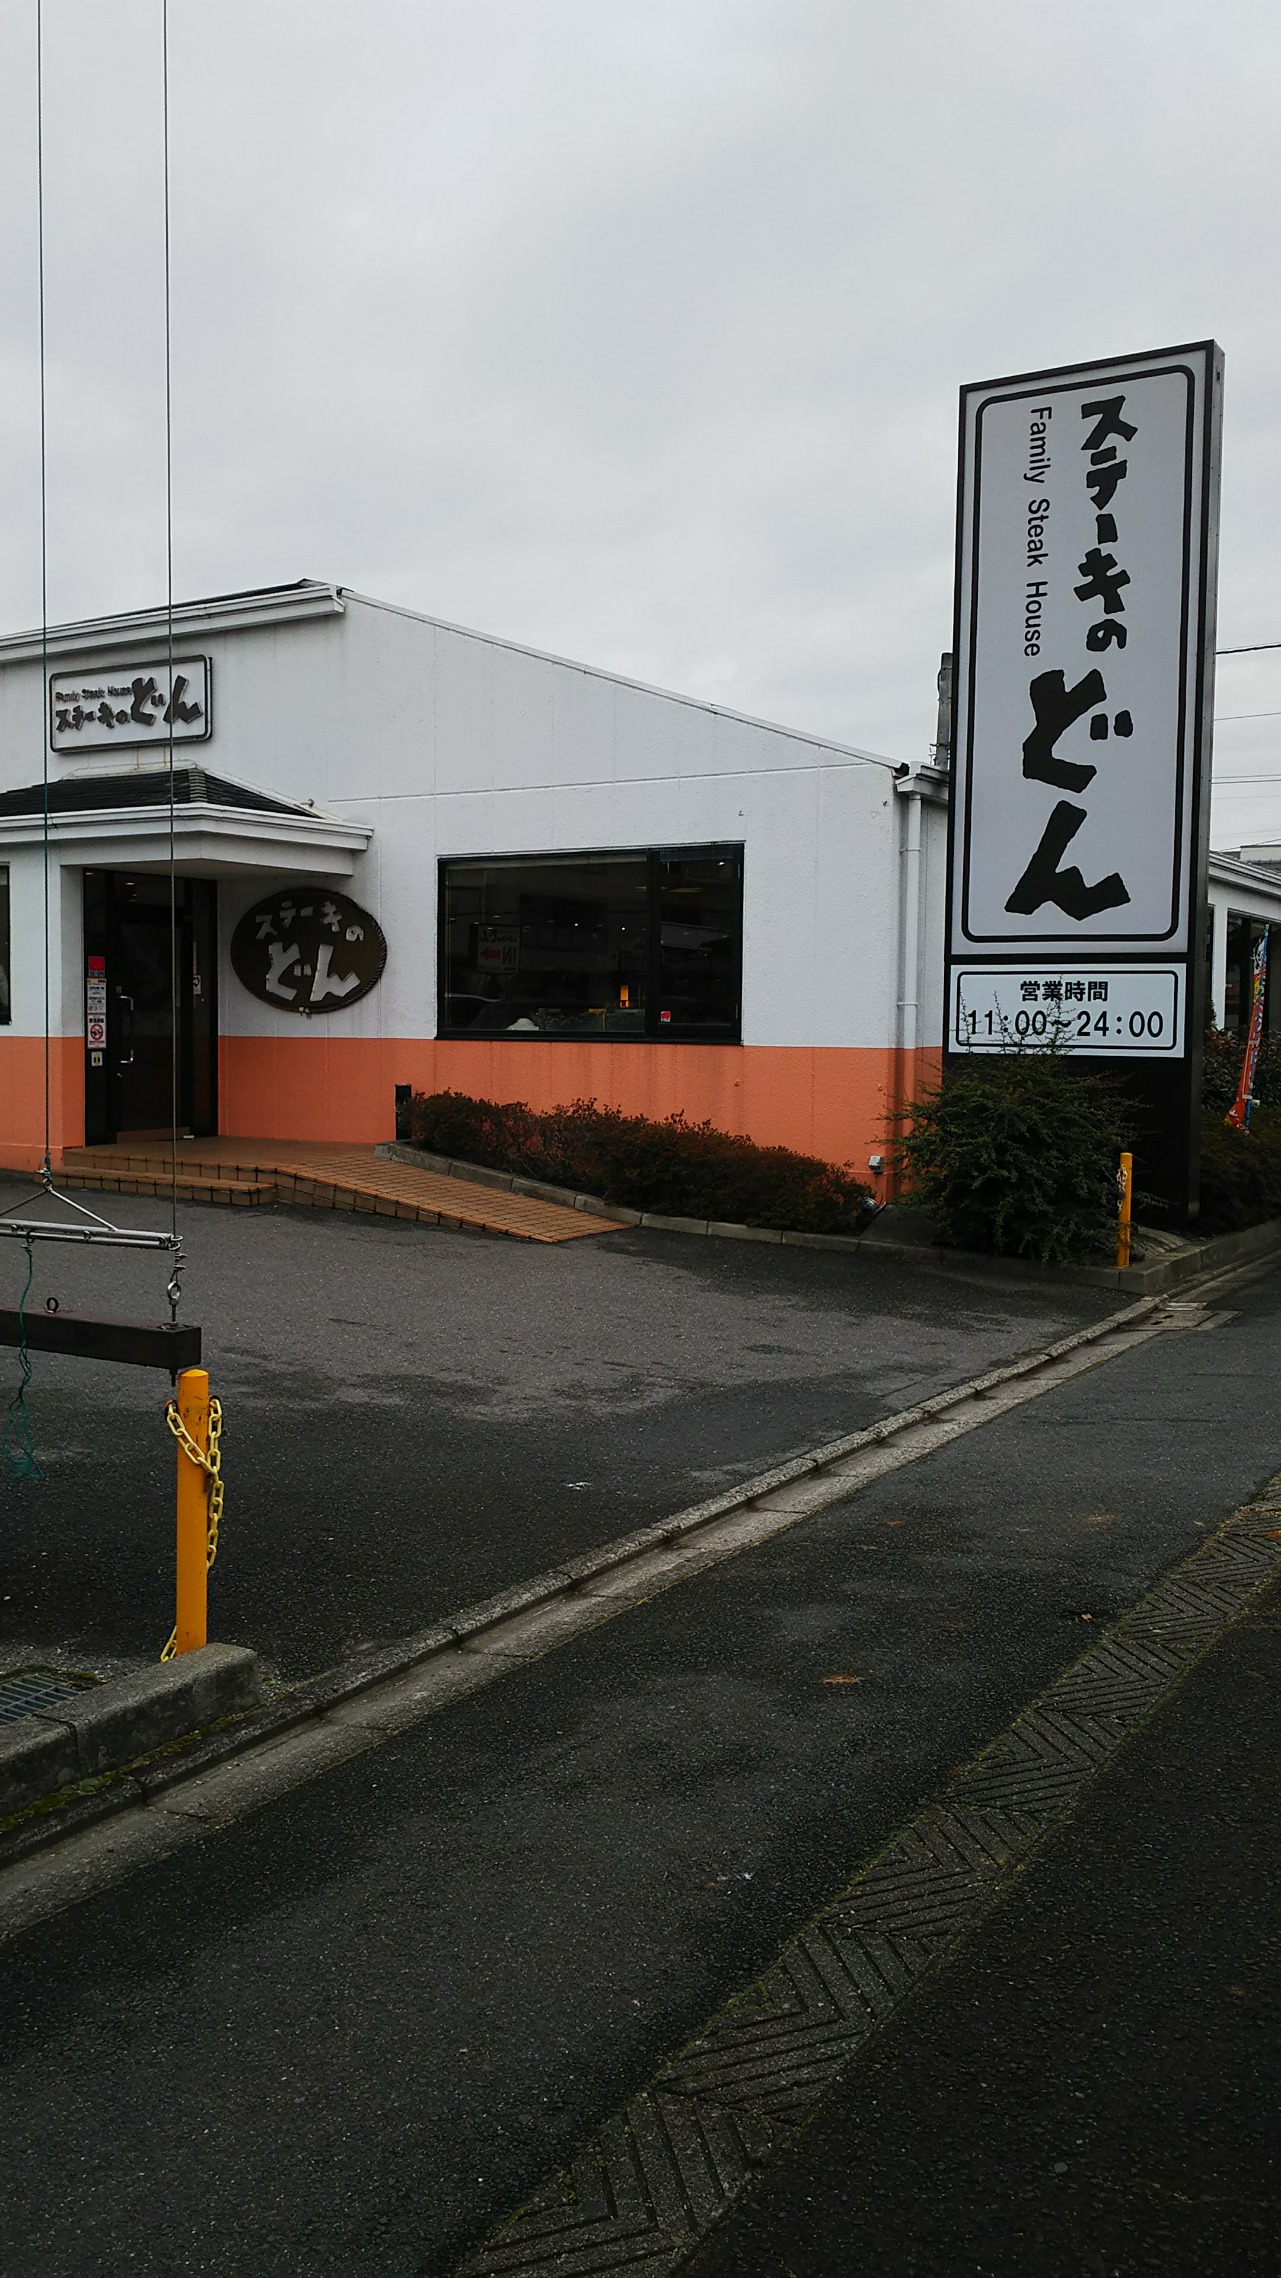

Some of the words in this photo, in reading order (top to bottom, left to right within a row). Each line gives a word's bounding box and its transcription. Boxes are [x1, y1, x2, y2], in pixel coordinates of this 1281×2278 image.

[1024, 406, 1053, 484] Family
[1026, 498, 1051, 568] Steak
[1024, 580, 1049, 657] House
[1019, 980, 1109, 1002] 営業時間
